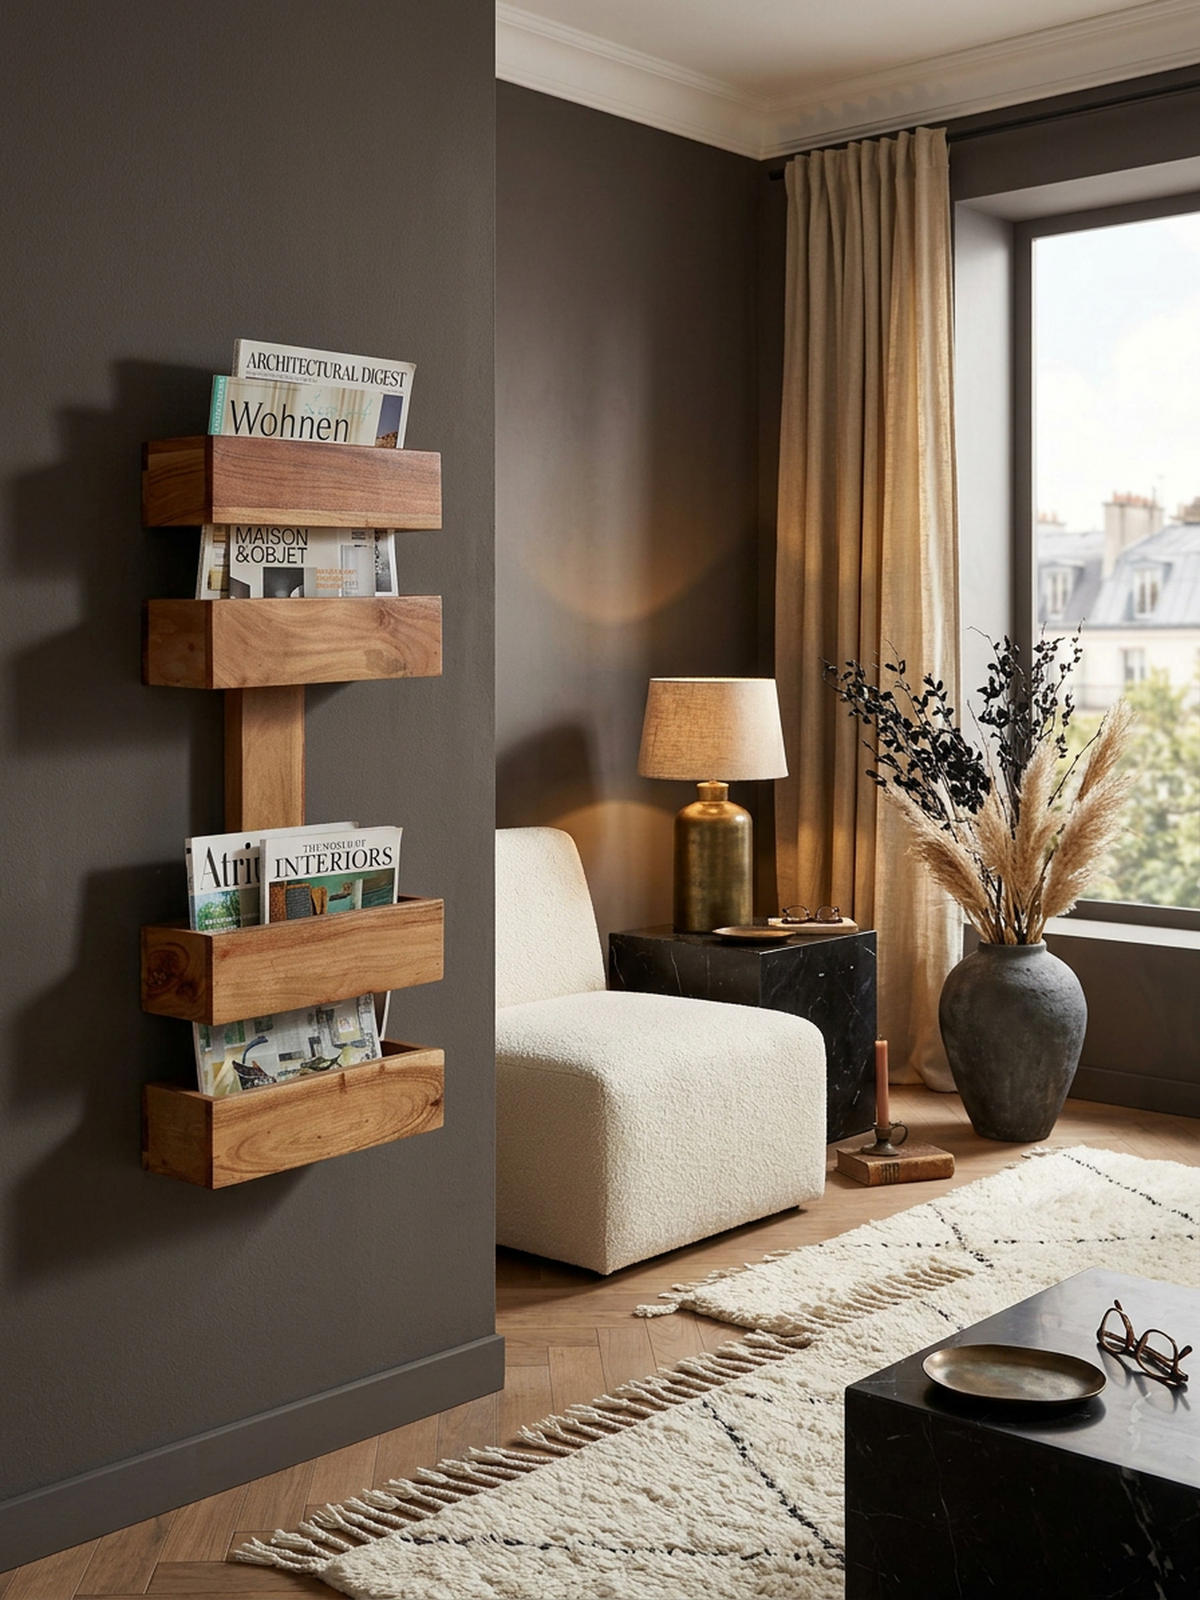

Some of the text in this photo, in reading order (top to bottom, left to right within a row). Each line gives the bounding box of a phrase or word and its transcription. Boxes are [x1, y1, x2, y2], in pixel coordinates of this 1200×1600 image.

[246, 351, 358, 382] ARCHITECTURAL
[361, 370, 407, 388] DIGEST
[230, 399, 349, 442] Wohnen
[236, 527, 308, 546] MAISON
[235, 545, 307, 564] &OBJET
[274, 846, 393, 879] INTERIORS
